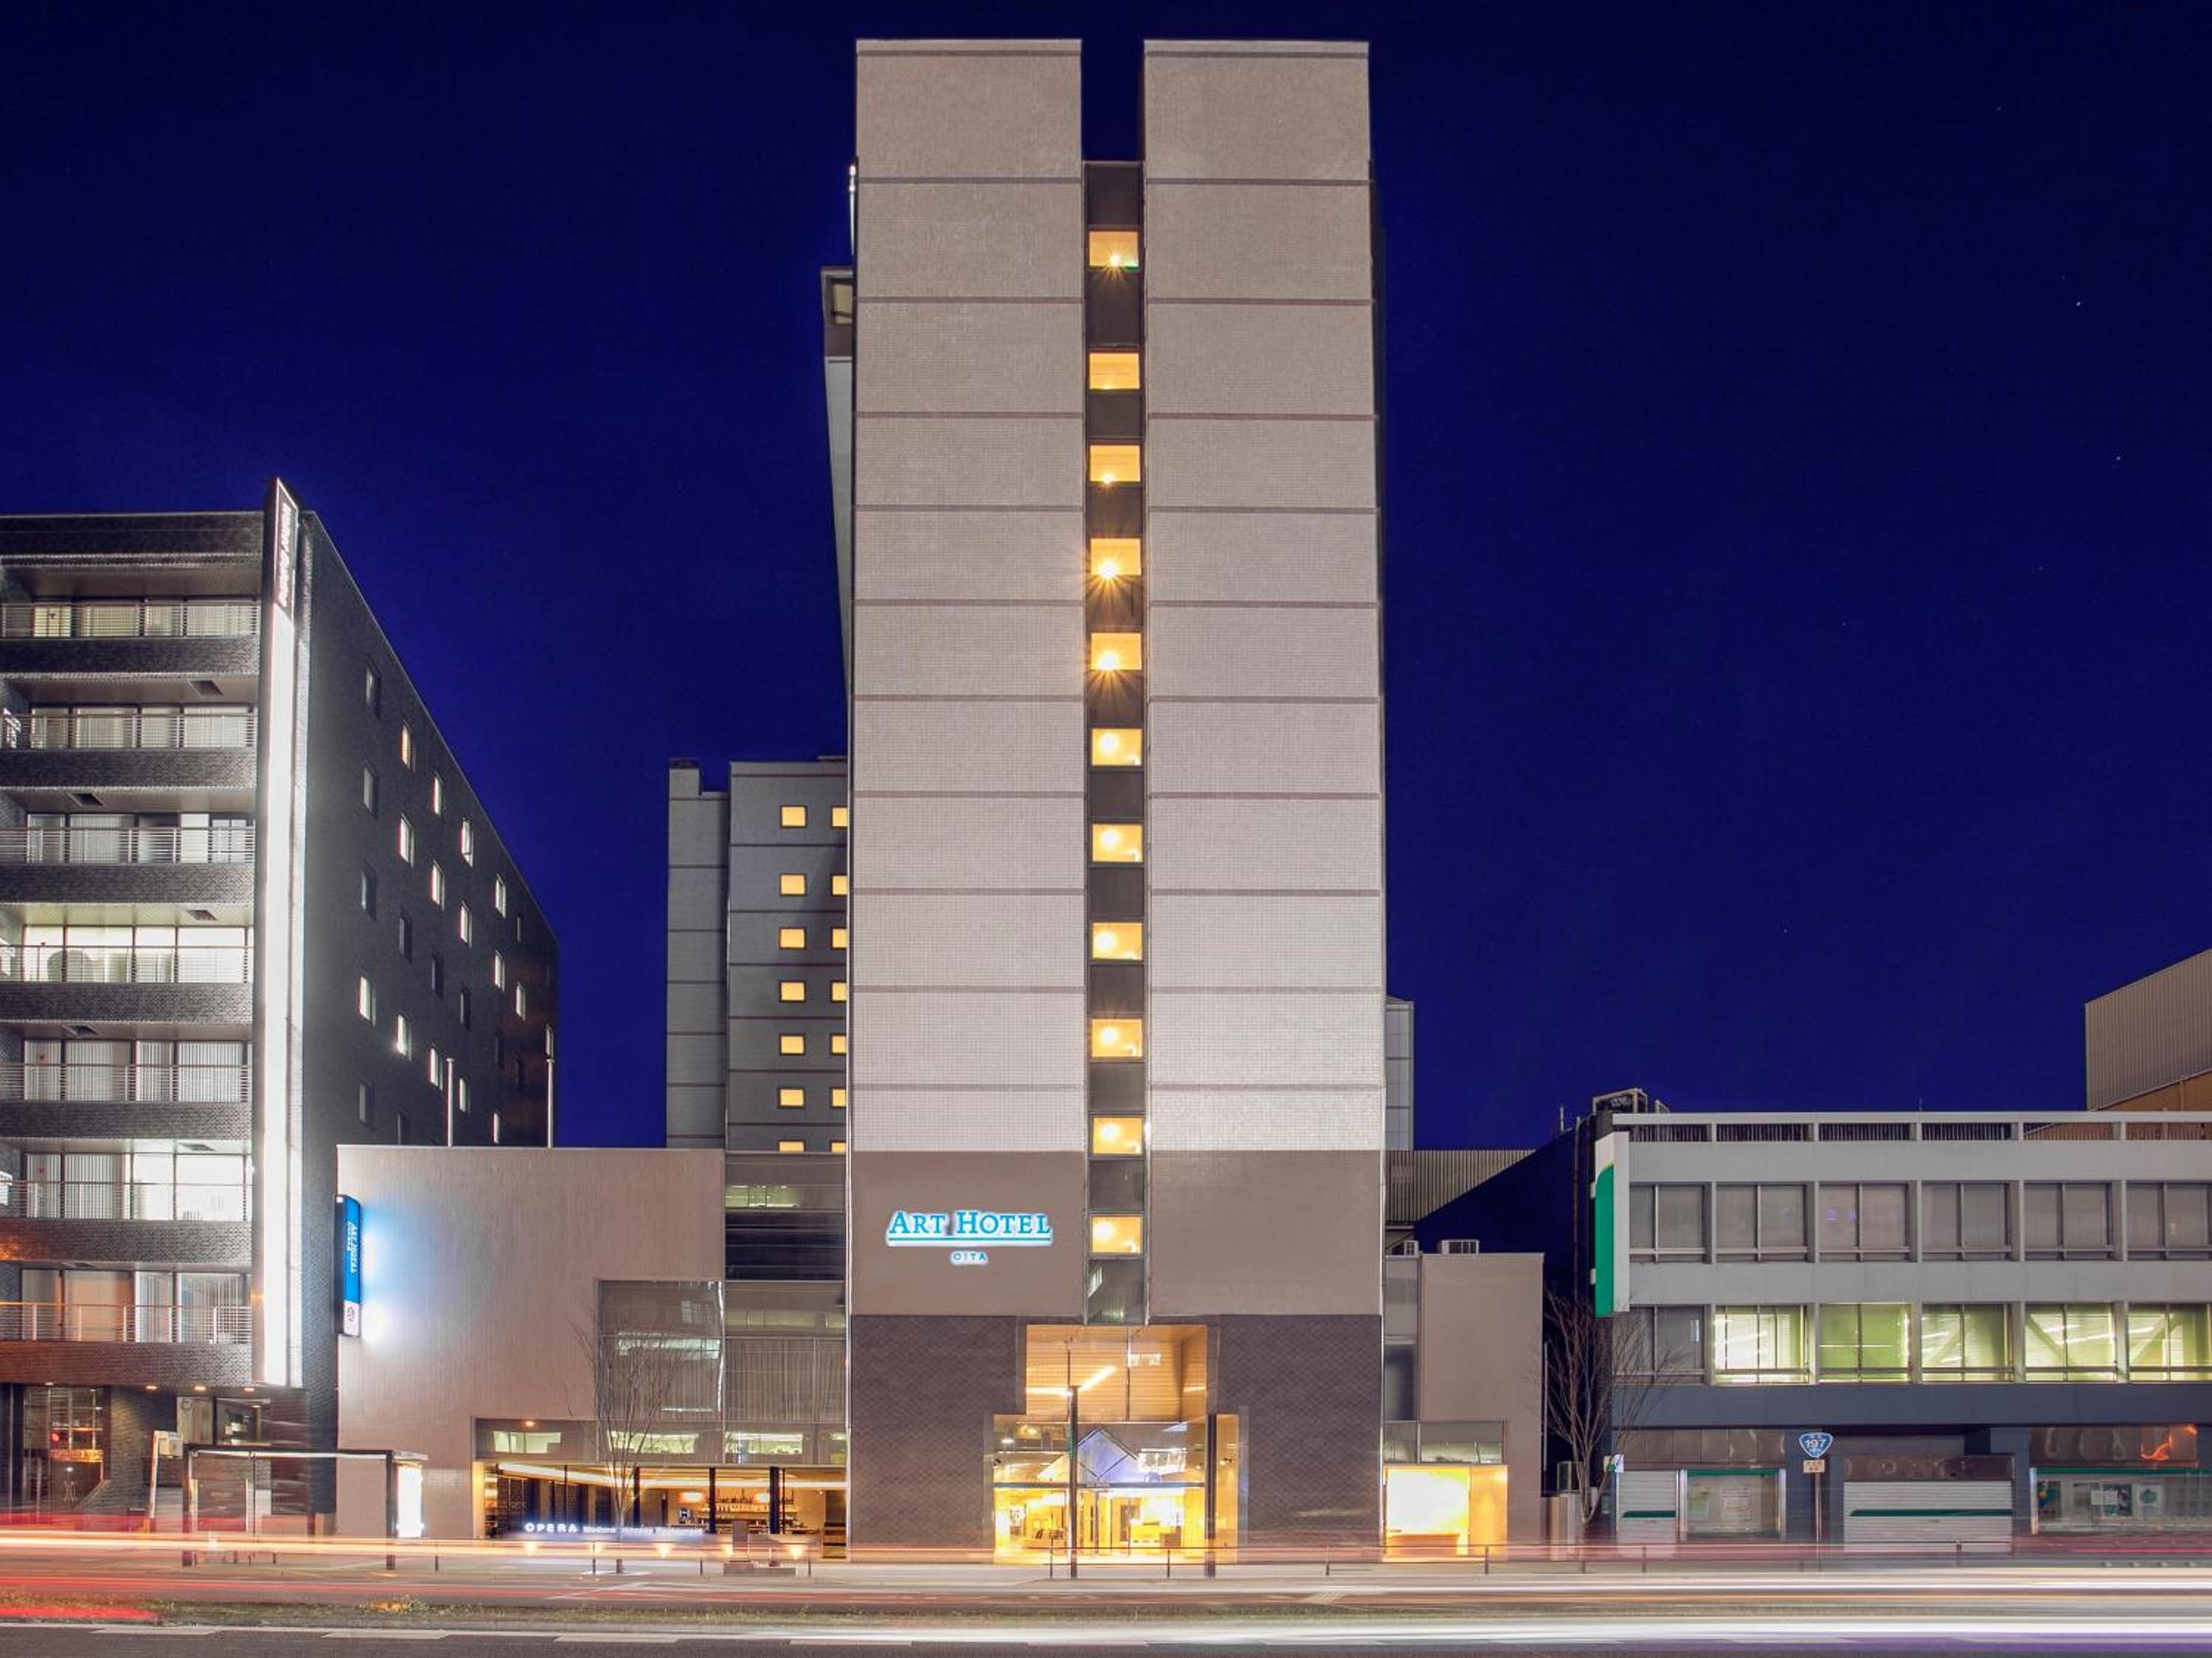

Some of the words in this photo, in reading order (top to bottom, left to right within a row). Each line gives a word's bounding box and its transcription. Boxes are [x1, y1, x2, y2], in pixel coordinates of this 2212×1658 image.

[888, 1211, 946, 1234] ART
[956, 1210, 1051, 1234] HOTEL
[952, 1252, 987, 1262] OITA
[1804, 1439, 1826, 1449] 197
[525, 1522, 577, 1533] OPERA
